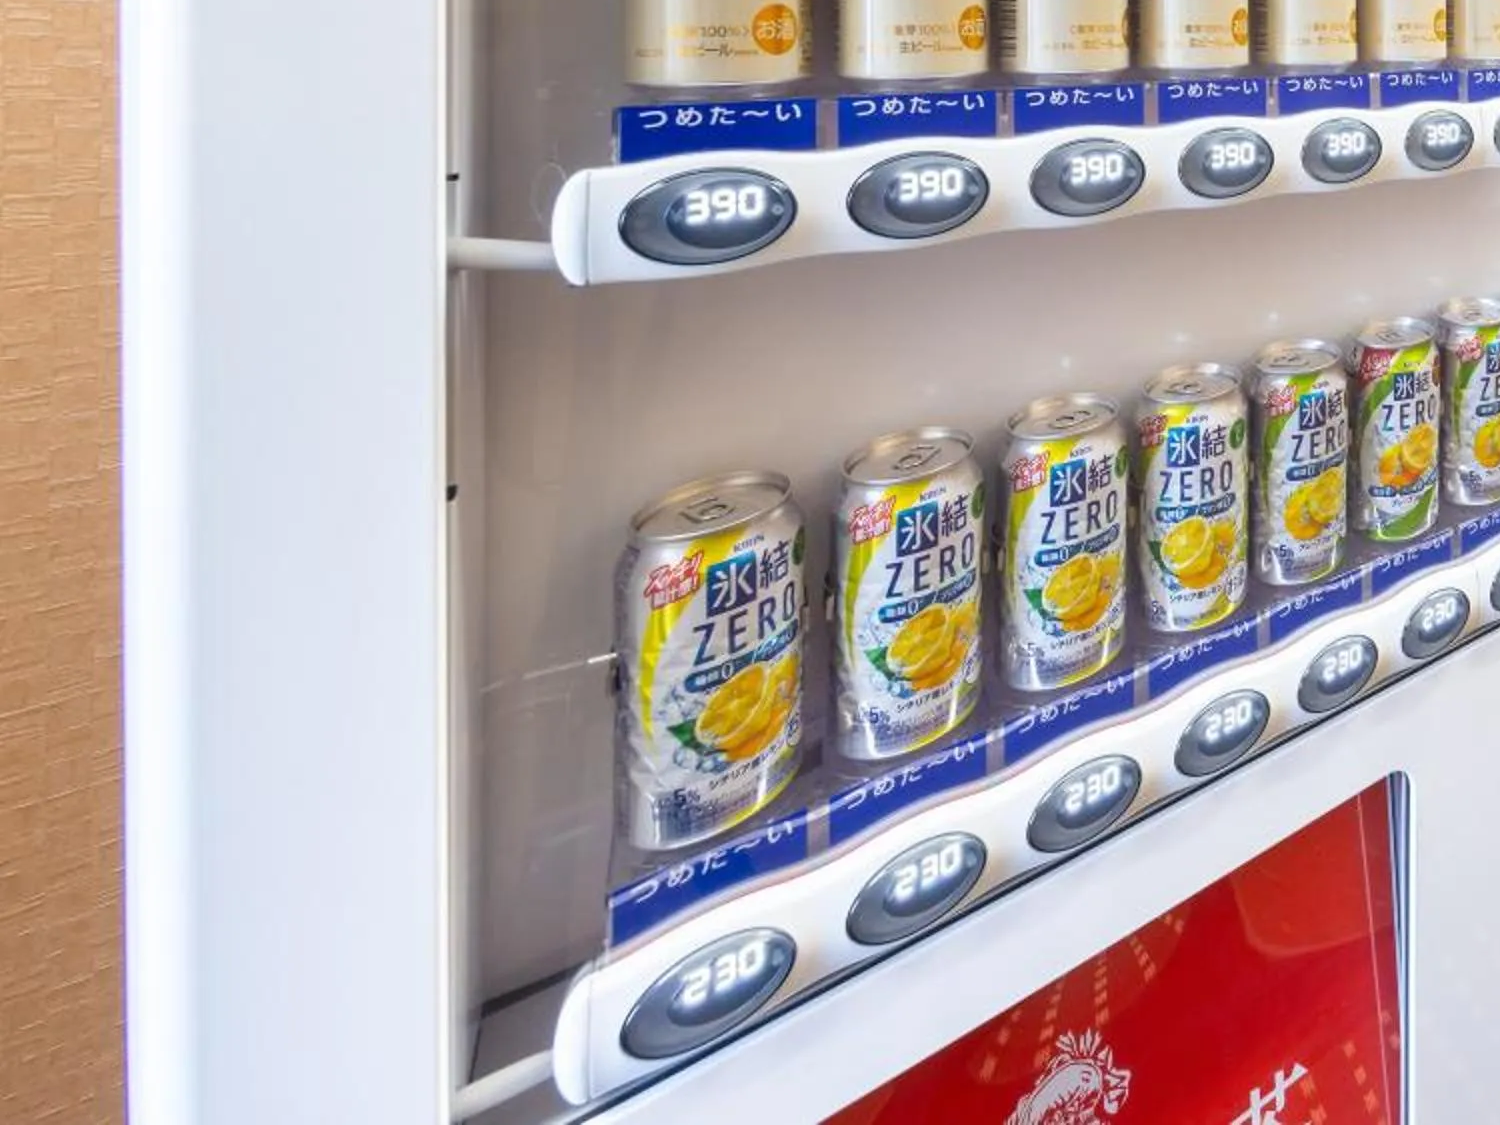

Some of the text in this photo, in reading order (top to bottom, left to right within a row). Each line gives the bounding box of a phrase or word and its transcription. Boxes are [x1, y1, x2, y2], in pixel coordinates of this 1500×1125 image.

[1210, 140, 1256, 171] 390
[1327, 131, 1366, 157] 390
[1425, 123, 1460, 146] 390
[899, 167, 965, 202] 390
[1069, 153, 1125, 185] 390
[685, 185, 766, 225] 390
[1381, 394, 1436, 432] ZERO
[1168, 424, 1227, 465] 氷結
[1052, 453, 1114, 504] 氷結
[1159, 460, 1234, 503] ZERO
[902, 493, 970, 554] 氷結
[1040, 489, 1119, 546] ZERO
[710, 538, 793, 616] 氷結
[885, 532, 976, 600] ZERO
[692, 580, 797, 667] ZERO
[1422, 597, 1457, 631] 230
[1322, 645, 1363, 682] 230
[1204, 700, 1252, 744] 230
[1063, 765, 1121, 815] 230
[894, 843, 963, 899] 230
[682, 943, 766, 1005] 230
